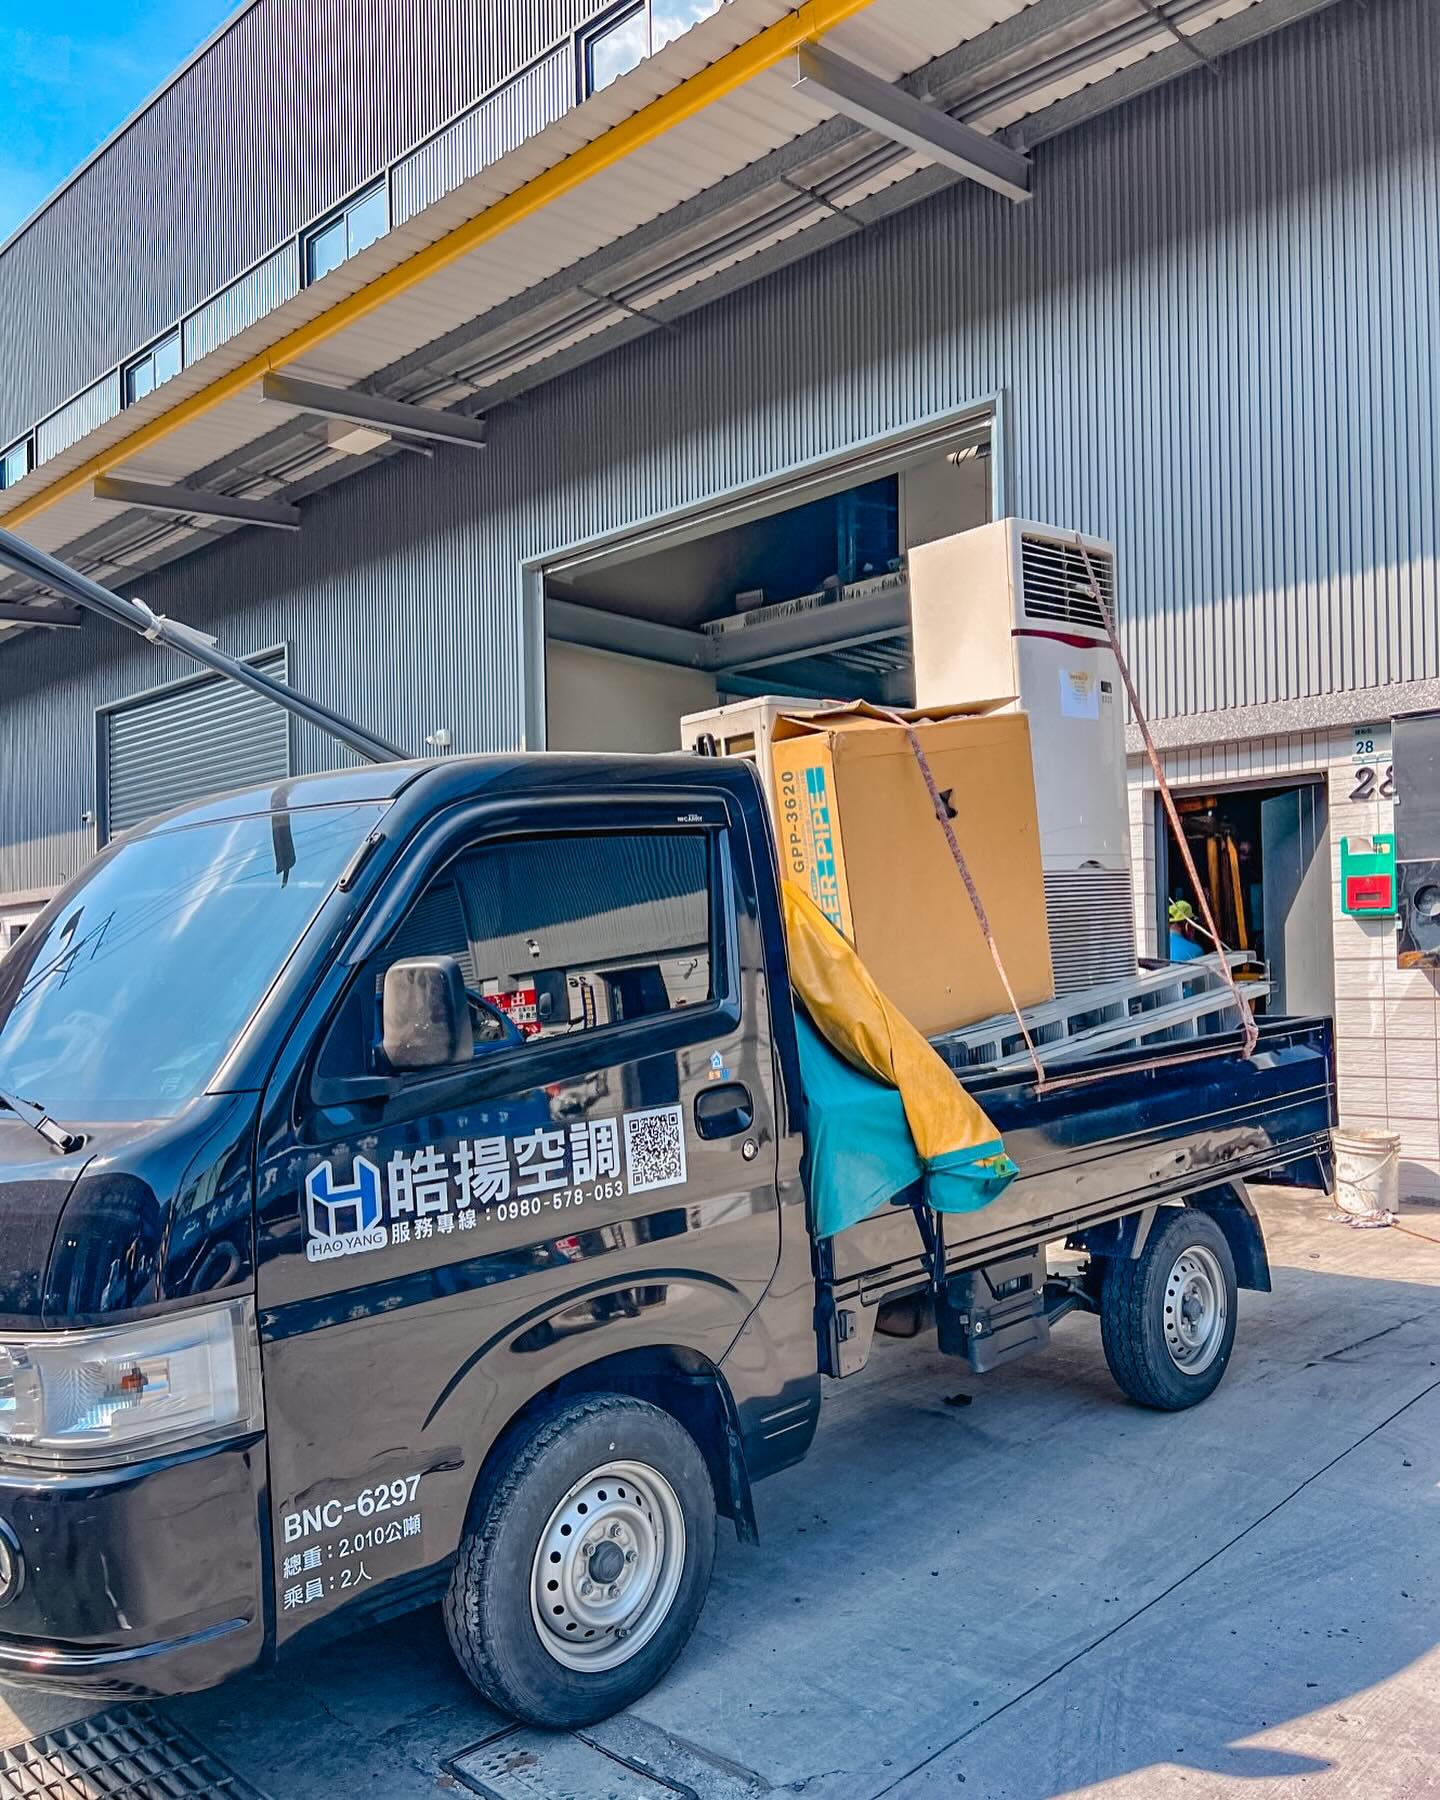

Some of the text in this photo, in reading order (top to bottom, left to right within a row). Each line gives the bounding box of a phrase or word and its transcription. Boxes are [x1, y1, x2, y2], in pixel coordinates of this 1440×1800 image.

[1356, 740, 1374, 755] 28
[782, 772, 805, 874] GPP-3620
[810, 791, 833, 861] PIPE
[387, 1117, 621, 1219] 皓揚空調
[312, 1232, 383, 1256] HAO YANG
[283, 1473, 422, 1544] BNC-6297
